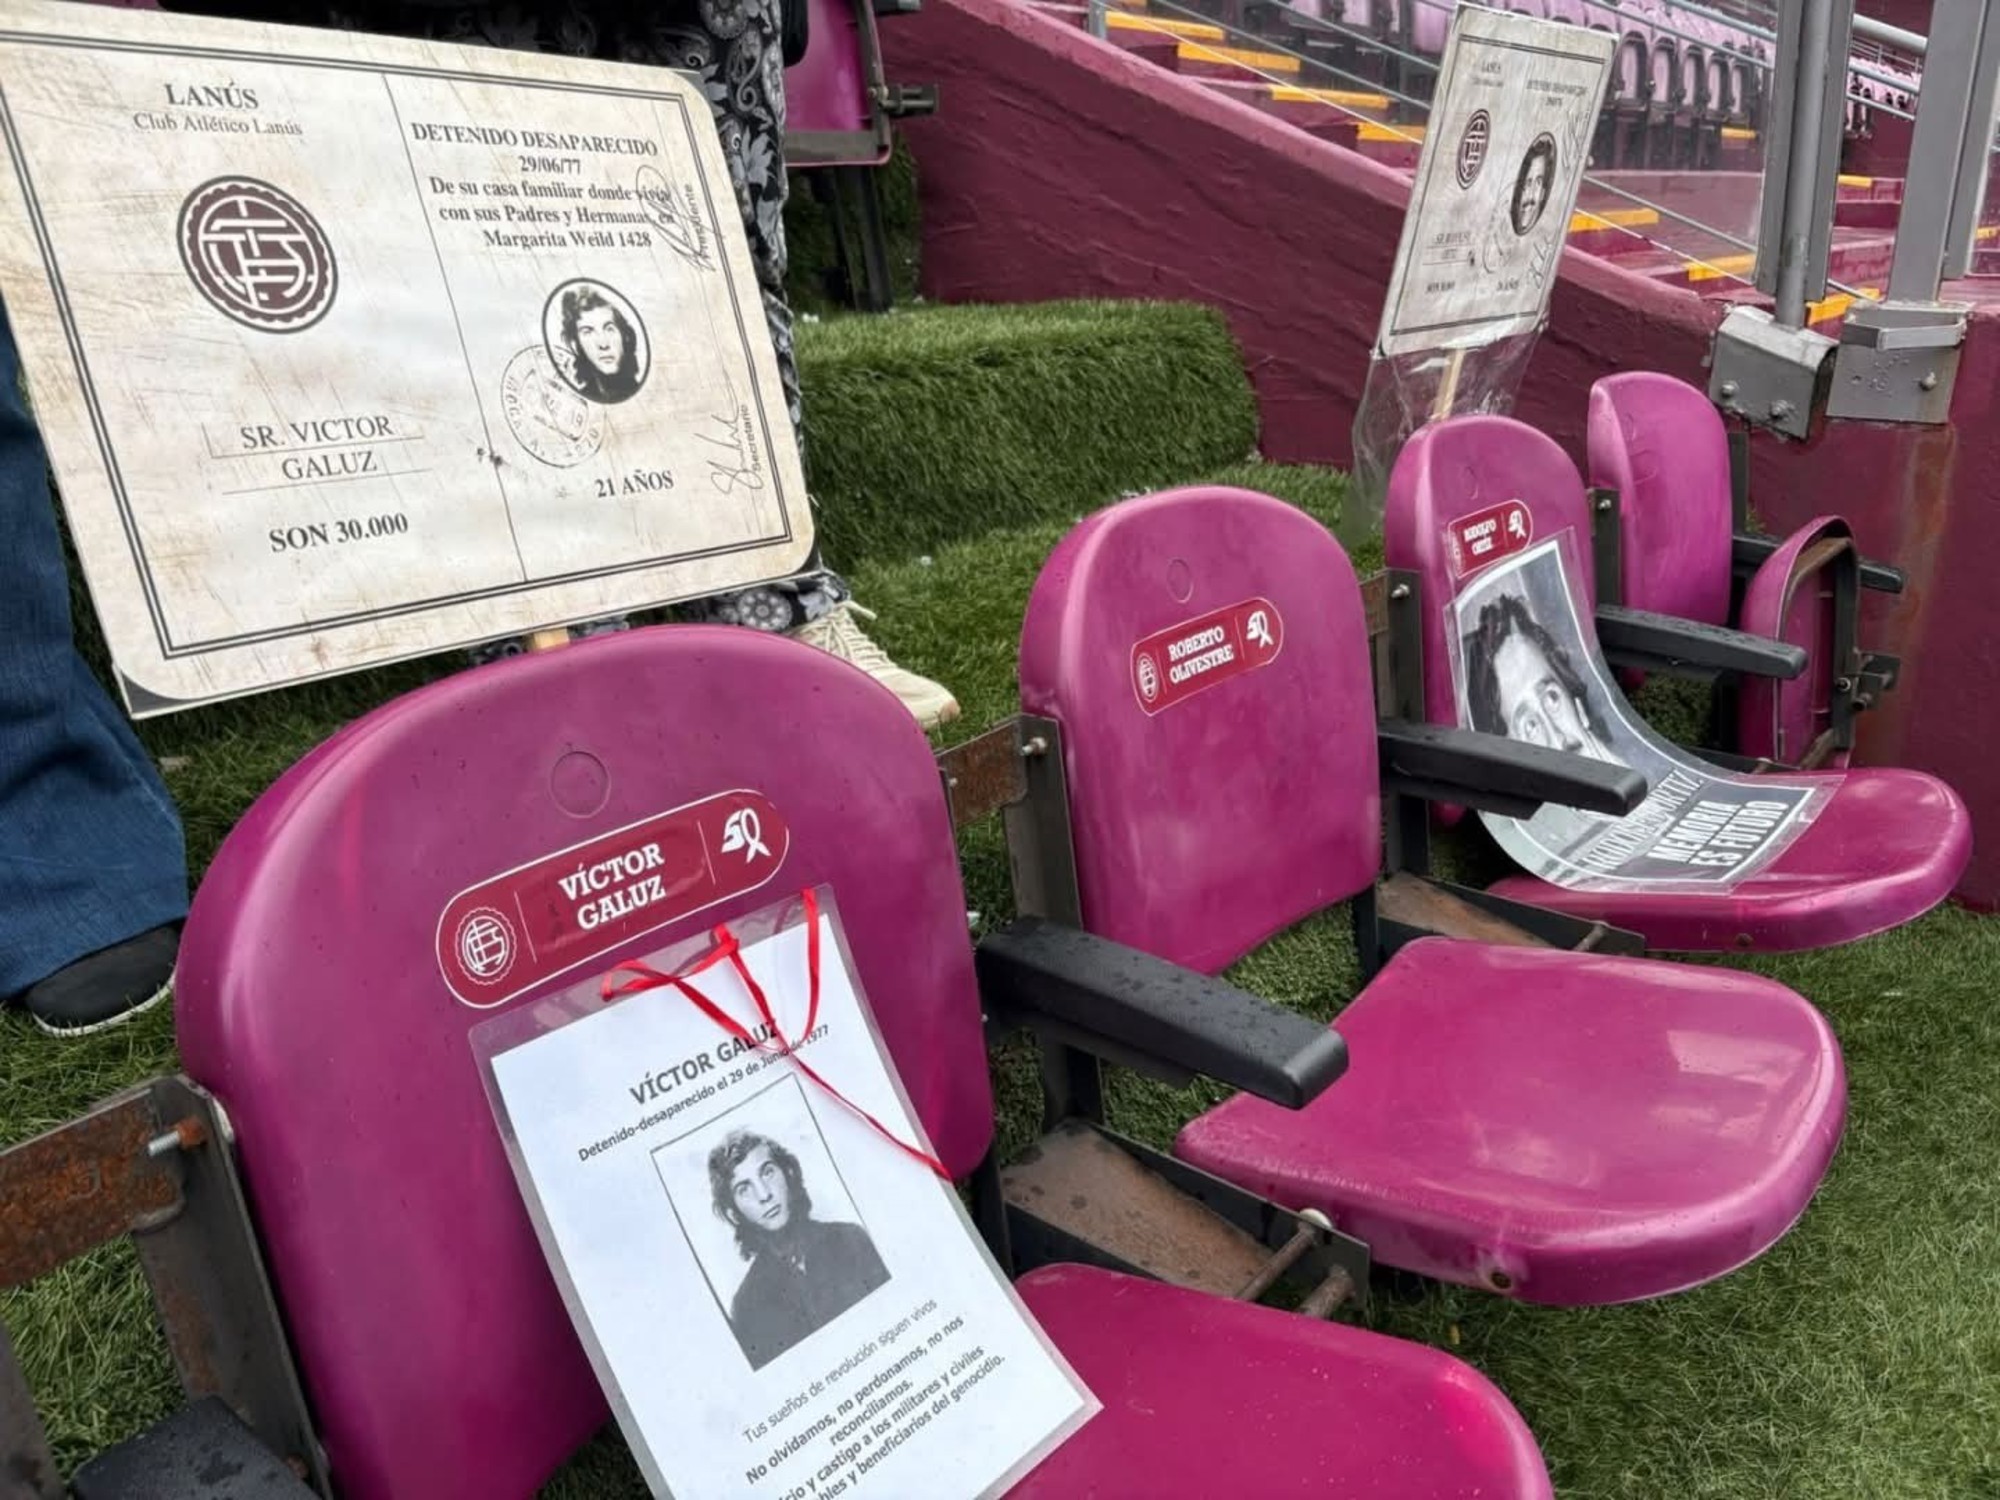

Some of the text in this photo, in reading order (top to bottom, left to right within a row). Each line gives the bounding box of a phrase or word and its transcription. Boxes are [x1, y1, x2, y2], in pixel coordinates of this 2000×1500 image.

[164, 81, 259, 110] LANÚS
[133, 112, 302, 136] Club Atlético Lanús
[411, 122, 658, 157] DETENIDO DESAPARECIDO
[429, 176, 456, 195] De
[458, 181, 479, 196] su
[482, 182, 517, 198] casa
[521, 178, 583, 200] familiar
[588, 183, 633, 201] donde
[517, 155, 582, 175] 29/06/77
[439, 207, 471, 223] con
[474, 208, 501, 223] sus
[505, 206, 560, 224] Padres
[562, 210, 573, 227] y
[483, 230, 652, 251] Margarita Weild 1428
[240, 415, 395, 450] SR. VICTOR
[740, 404, 762, 472] Secretario
[281, 451, 378, 481] GALUZ
[595, 468, 675, 499] 21 AÑOS
[269, 512, 409, 553] SON 30.000
[1167, 625, 1225, 662] ROBERTO
[1645, 799, 1743, 864] MEMORIA
[1688, 799, 1790, 867] ES FUTURO
[558, 842, 664, 901] VÍCTOR
[576, 875, 668, 931] GALUZ
[628, 1051, 715, 1106] VÍCTOR
[578, 1085, 715, 1162] Detenido-desaparecido
[717, 1076, 729, 1092] el
[730, 1070, 744, 1085] 29
[745, 1062, 760, 1076] de
[743, 1298, 938, 1444] Tus sueños de revolución siguen vivos
[746, 1315, 964, 1485] No olvidamos, no perdonamos, no nos
[779, 1344, 985, 1500] cio y castigo a los militares y civiles
[829, 1379, 914, 1446] reconciliamos.
[815, 1355, 1006, 1500] bles y beneficiarios del genocidio.
